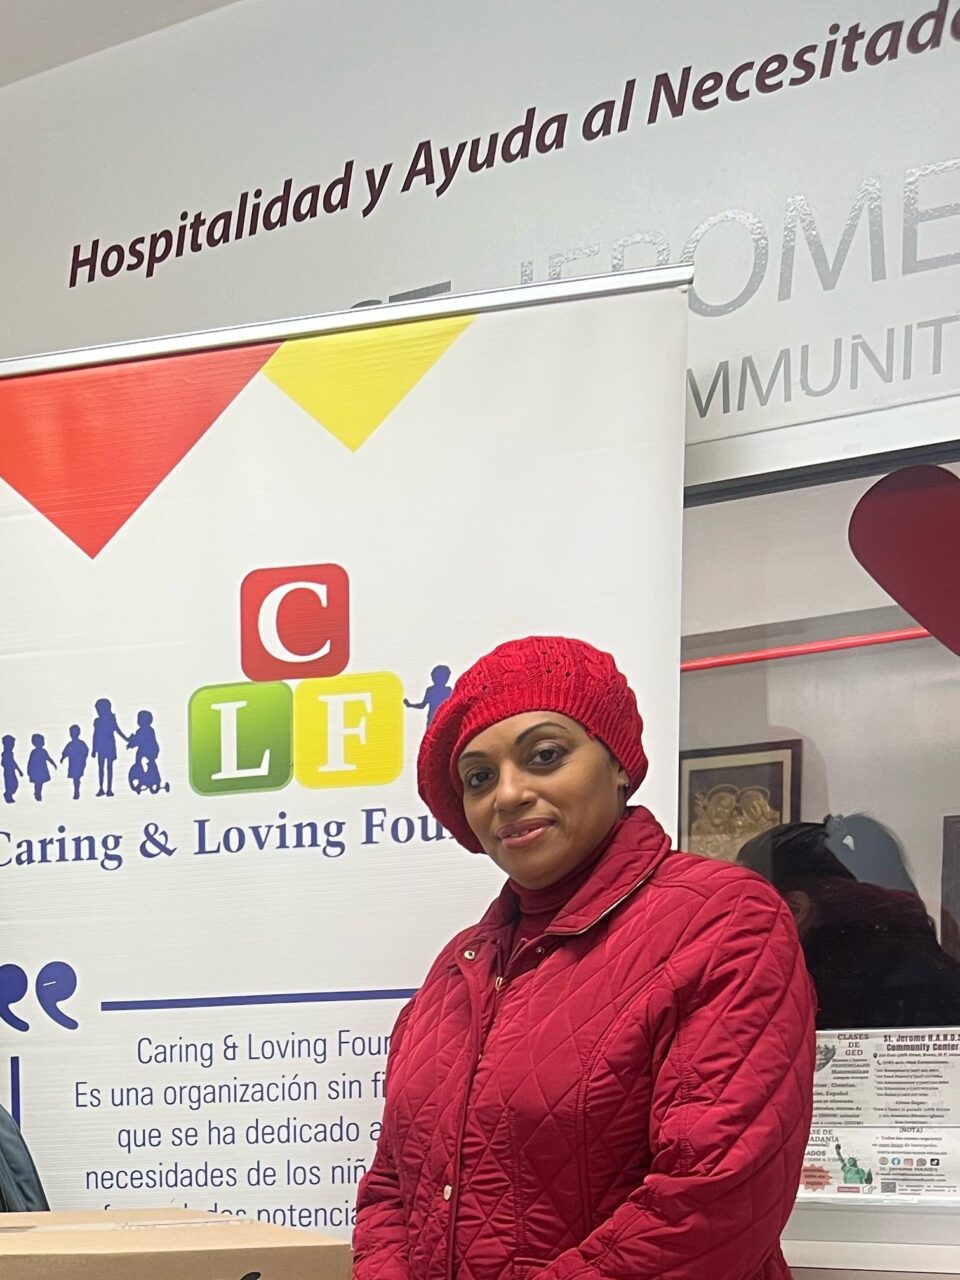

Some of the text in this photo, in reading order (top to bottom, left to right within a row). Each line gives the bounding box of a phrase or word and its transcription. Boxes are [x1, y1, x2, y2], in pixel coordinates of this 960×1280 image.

[69, 162, 354, 286] Hospitalidad
[363, 165, 393, 216] y
[400, 107, 567, 196] Ayuda
[582, 80, 637, 141] al
[257, 581, 331, 663] C
[211, 692, 373, 781] L F
[140, 822, 177, 858] &
[193, 811, 346, 858] Loving
[360, 808, 454, 845] Fou
[137, 1036, 213, 1068] Caring
[223, 1034, 239, 1061] &
[248, 1032, 327, 1064] Loving
[886, 1043, 959, 1051] Community Center
[896, 1034, 925, 1042] Jerome
[75, 1082, 101, 1108] Es
[112, 1086, 153, 1106] una
[163, 1074, 318, 1110] organización
[328, 1072, 362, 1100] sin
[117, 1126, 162, 1154] que
[171, 1124, 198, 1147] se
[208, 1120, 236, 1145] ha
[245, 1115, 360, 1144] dedicado
[85, 1161, 237, 1190] necesidades
[247, 1160, 277, 1187] de
[286, 1159, 321, 1185] los
